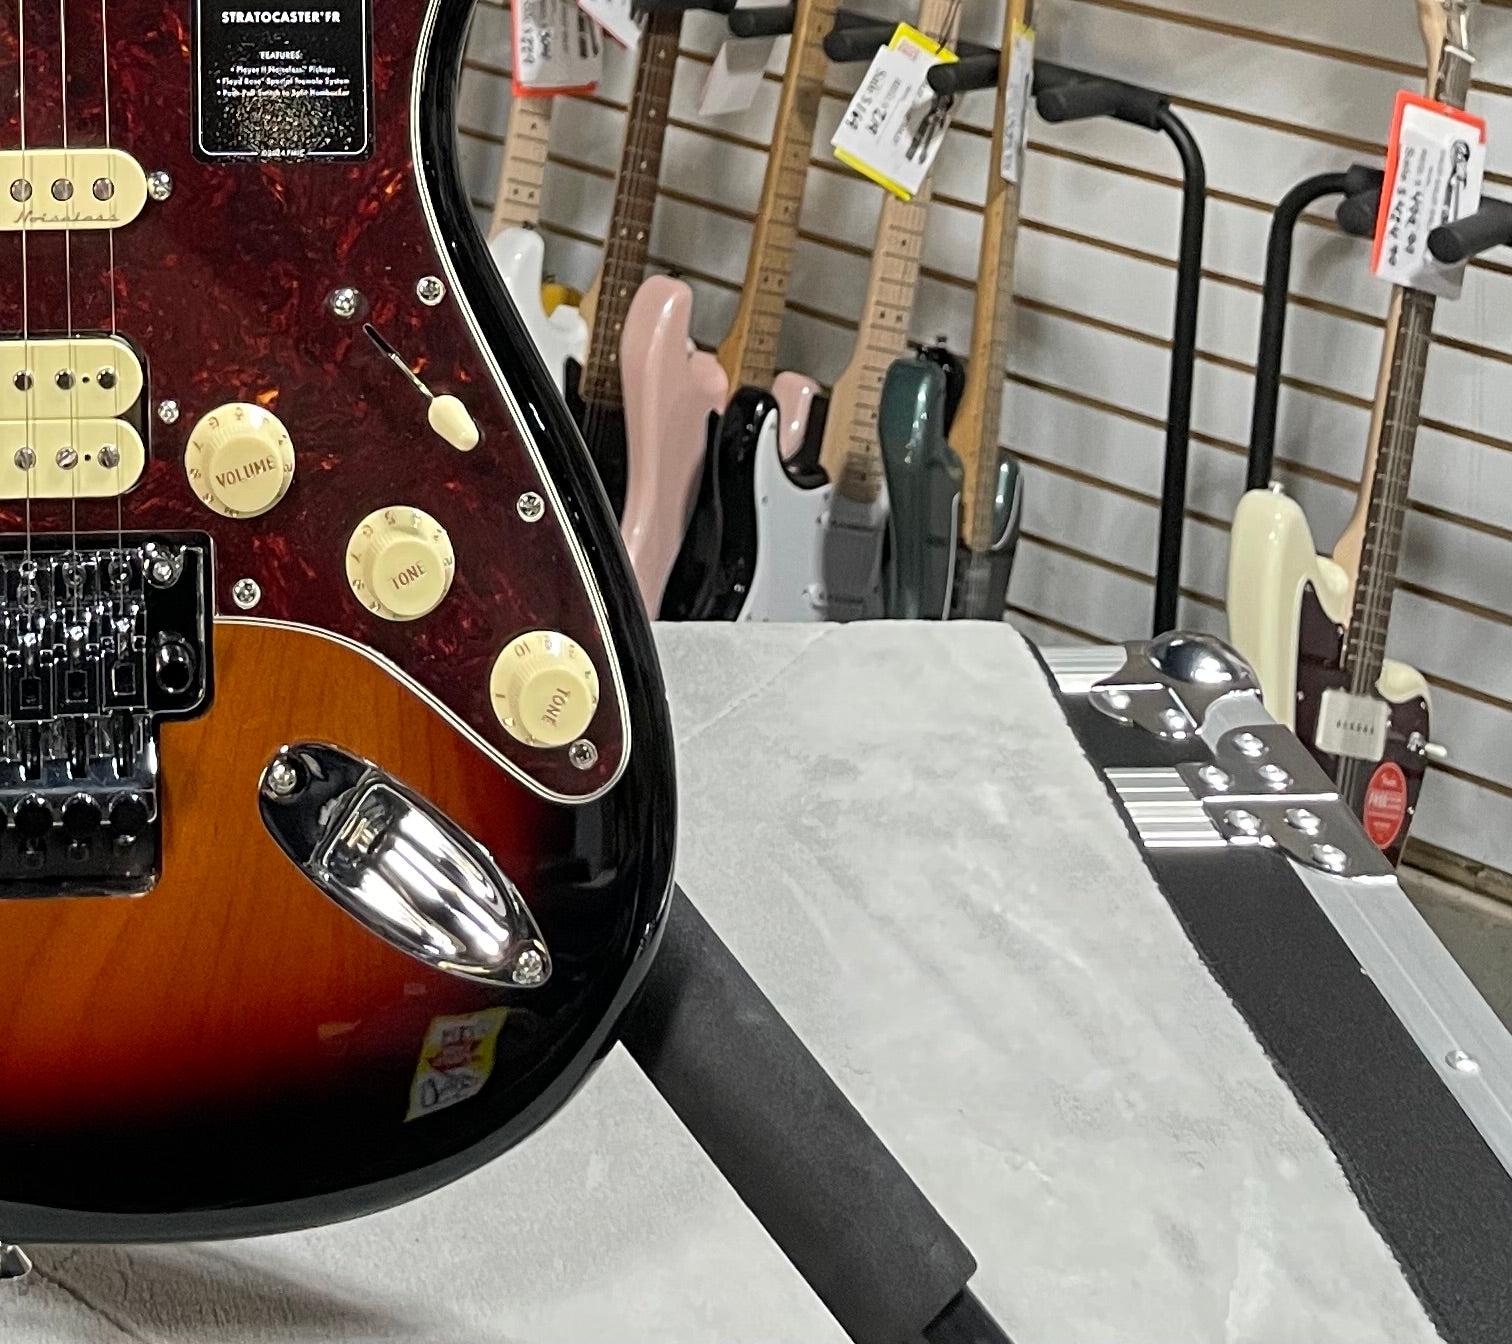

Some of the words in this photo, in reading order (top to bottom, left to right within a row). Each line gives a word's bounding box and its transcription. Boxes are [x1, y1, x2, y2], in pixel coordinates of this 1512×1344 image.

[325, 11, 341, 23] FR
[258, 50, 304, 61] FEATURES:
[13, 209, 121, 223] Noiseless
[215, 454, 276, 489] VOLUME
[389, 559, 428, 591] TONE
[540, 687, 572, 728] TONE
